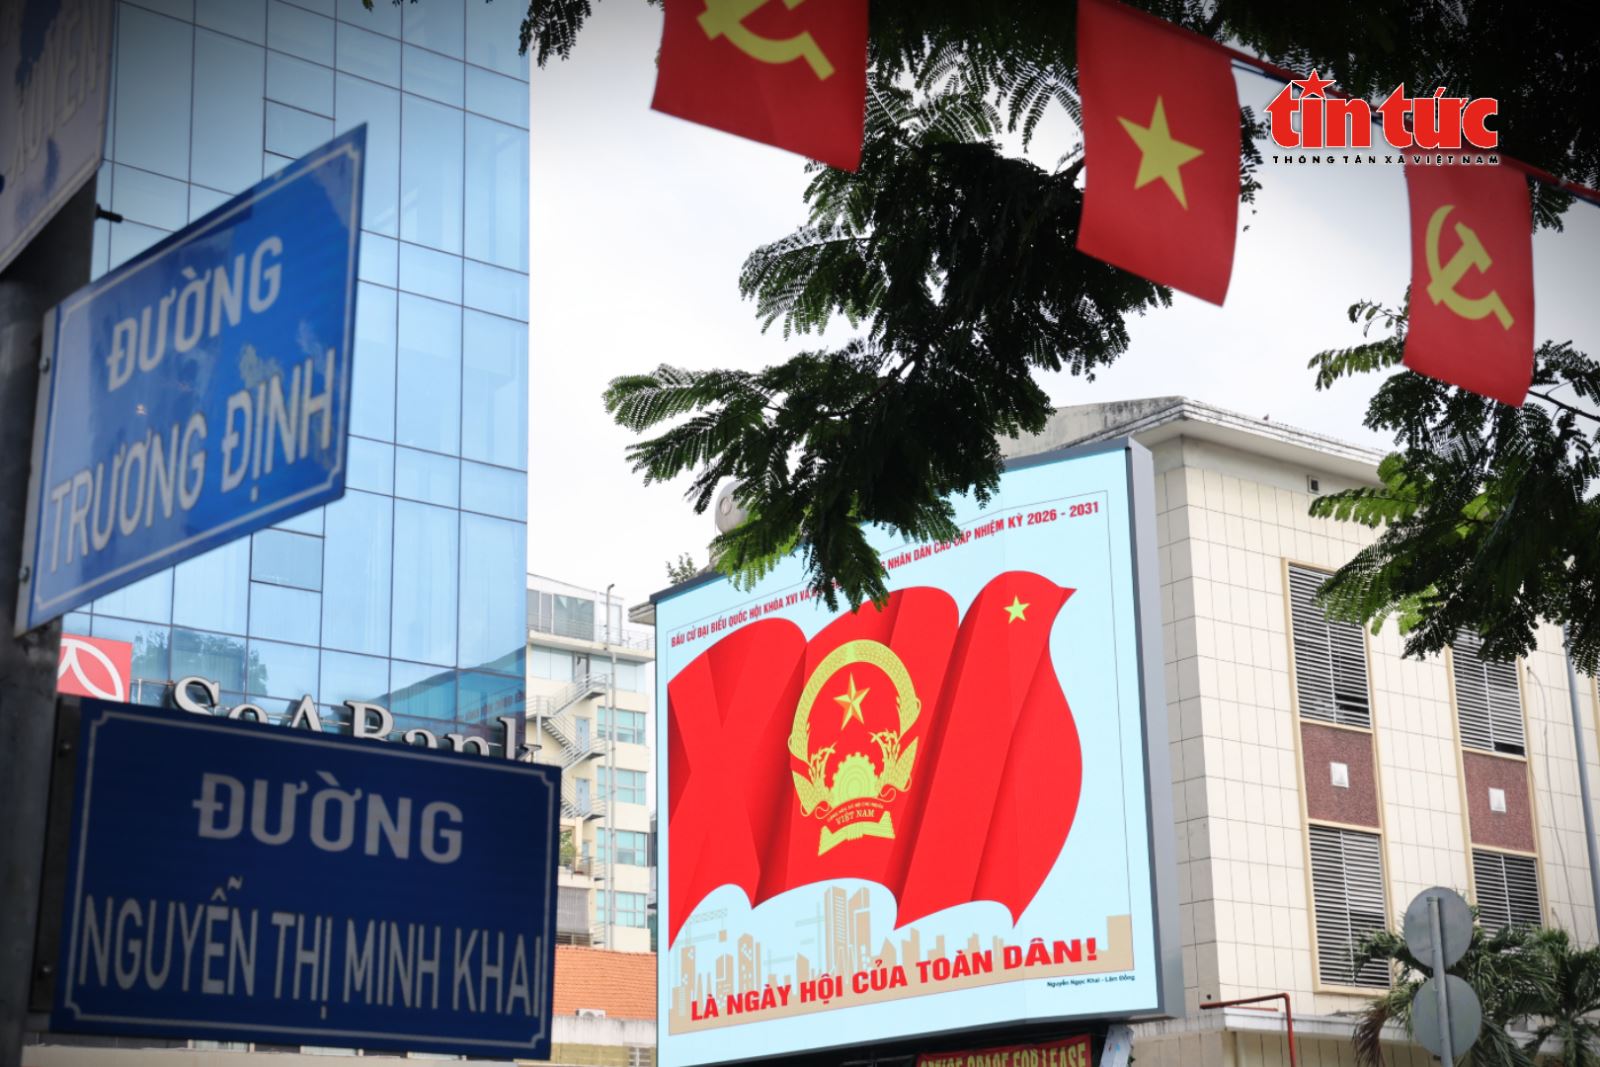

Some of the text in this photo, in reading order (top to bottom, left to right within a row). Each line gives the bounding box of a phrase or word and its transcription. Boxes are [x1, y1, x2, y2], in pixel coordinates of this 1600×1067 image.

[106, 236, 283, 392] ĐƯỜNG
[50, 348, 336, 573] TRƯƠNG ĐỊNH
[785, 592, 798, 606] XVI
[888, 552, 912, 570] NHÂN
[914, 543, 932, 560] DÂN
[974, 518, 1004, 540] NHIỆM
[1008, 513, 1023, 529] KỲ
[1027, 509, 1057, 525] 2026
[1069, 501, 1099, 518] 2031
[193, 771, 464, 864] ĐƯỜNG
[78, 876, 542, 1020] NGUYỄN THỊ MINH KHAI
[691, 937, 1097, 1021] LÀ NGÀY HỘI CỦA TOÀN DÂN!
